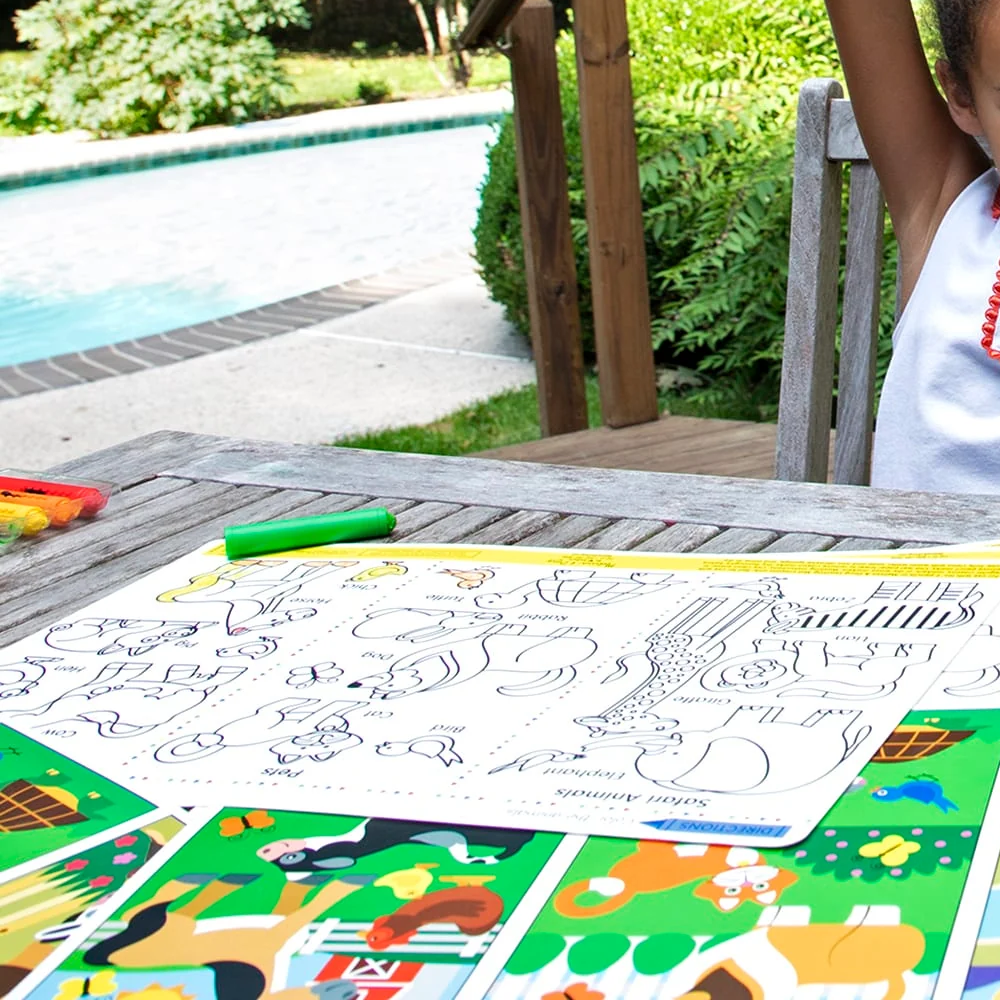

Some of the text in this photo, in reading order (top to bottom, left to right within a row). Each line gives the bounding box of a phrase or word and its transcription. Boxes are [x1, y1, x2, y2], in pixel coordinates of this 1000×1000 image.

[340, 583, 378, 591] Chick
[425, 594, 465, 602] Turtle
[518, 613, 568, 621] Rabbit
[174, 639, 199, 648] Pig
[361, 651, 395, 661] Dog
[54, 665, 88, 673] Hen
[673, 696, 731, 705] Giraffe
[363, 710, 394, 719] Cat
[429, 724, 466, 733] Bird
[42, 729, 77, 738] Cow
[261, 767, 304, 778] Pets
[543, 767, 626, 780] Elephant
[554, 788, 712, 808] Safari Animals
[680, 821, 774, 836] DIRECTIONS
